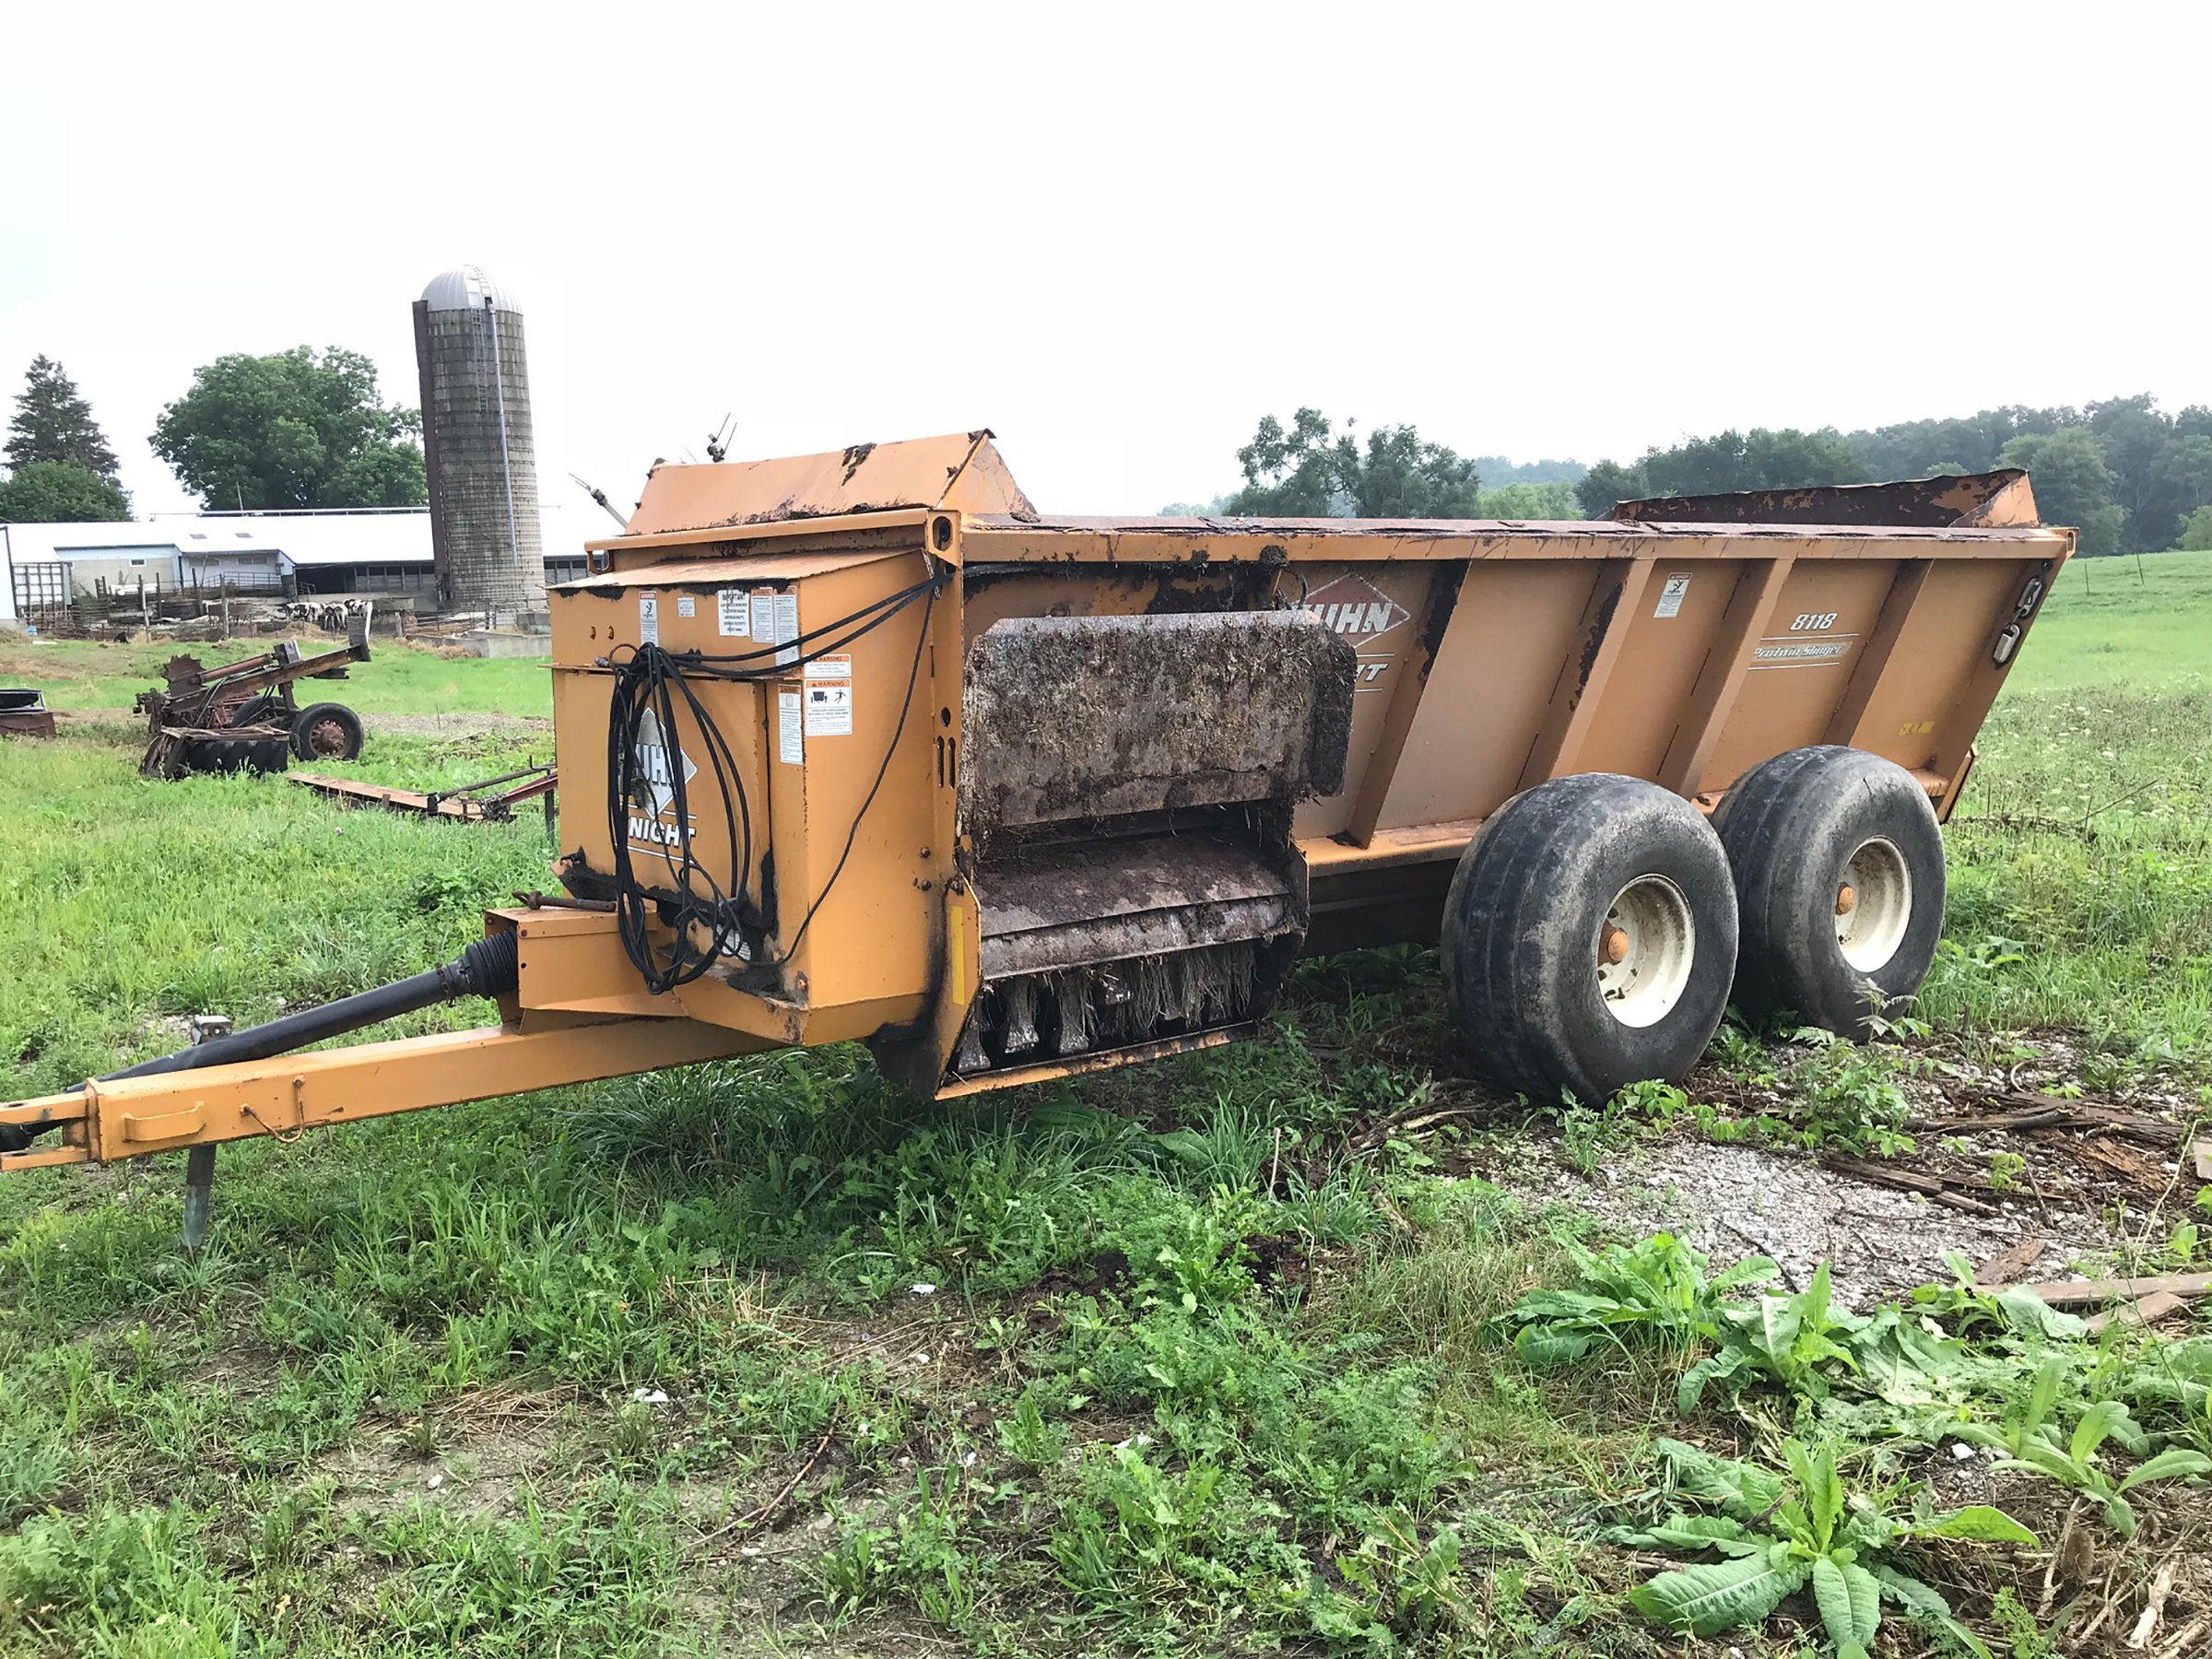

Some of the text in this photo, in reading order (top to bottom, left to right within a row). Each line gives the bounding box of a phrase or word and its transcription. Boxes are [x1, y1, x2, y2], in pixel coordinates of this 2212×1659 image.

[1304, 603, 1393, 633] UHN
[1790, 613, 1838, 630] 8118
[1801, 646, 1842, 657] Slinger
[629, 817, 696, 847] NIGHT
